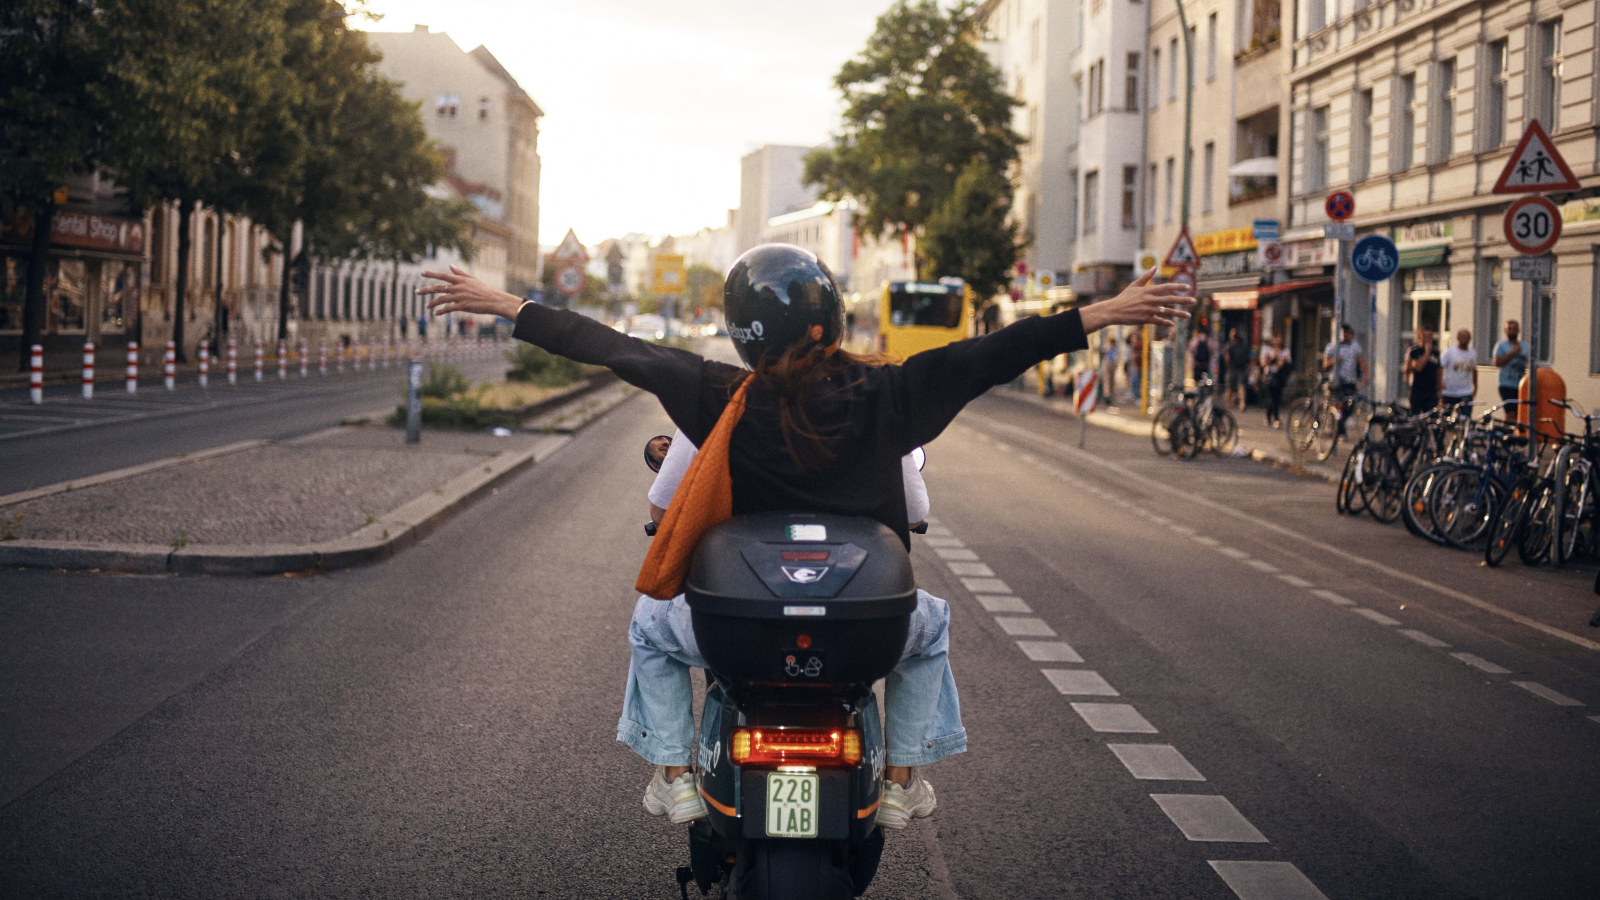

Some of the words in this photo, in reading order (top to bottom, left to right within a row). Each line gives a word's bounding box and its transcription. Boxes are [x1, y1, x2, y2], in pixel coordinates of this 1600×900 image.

[90, 216, 117, 242] Shop
[1516, 211, 1549, 239] 30
[772, 778, 812, 803] 228
[776, 807, 811, 832] IAB
